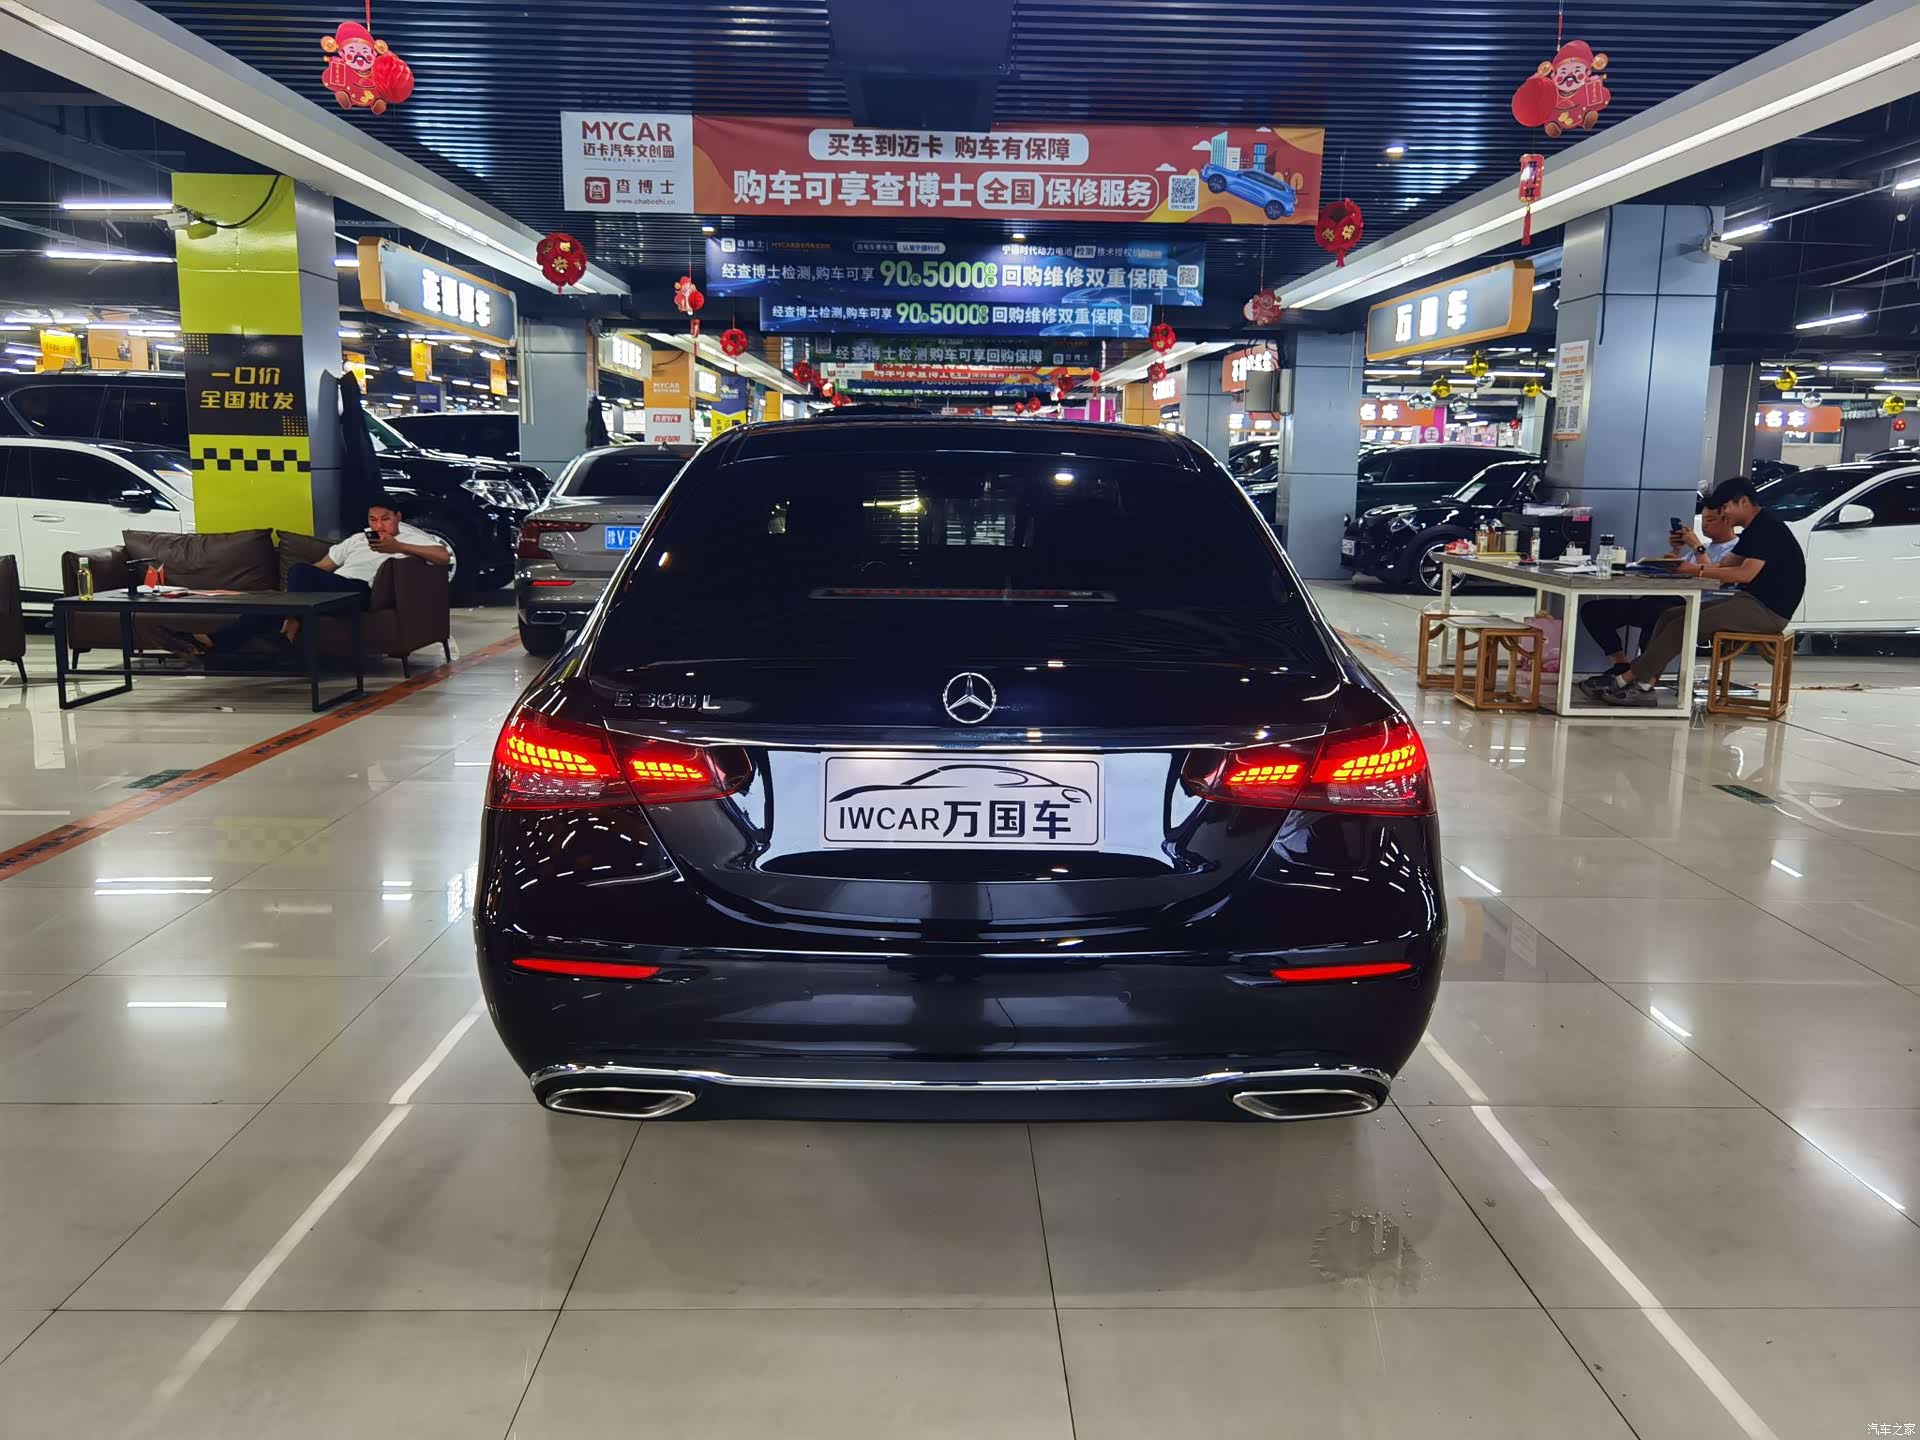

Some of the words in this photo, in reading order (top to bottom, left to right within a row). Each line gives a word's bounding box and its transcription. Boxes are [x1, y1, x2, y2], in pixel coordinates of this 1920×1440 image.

[581, 121, 673, 142] MYCAR
[583, 143, 675, 159] 迈卡汽车文创园
[828, 133, 943, 158] 买车到迈卡
[954, 136, 1070, 161] 购车有保障
[616, 179, 676, 195] 查博士
[1001, 264, 1169, 289] 回购维修双重保障
[992, 306, 1124, 326] 回购维修双重保障
[211, 366, 281, 385] 一口价
[200, 390, 294, 410] 全国批发
